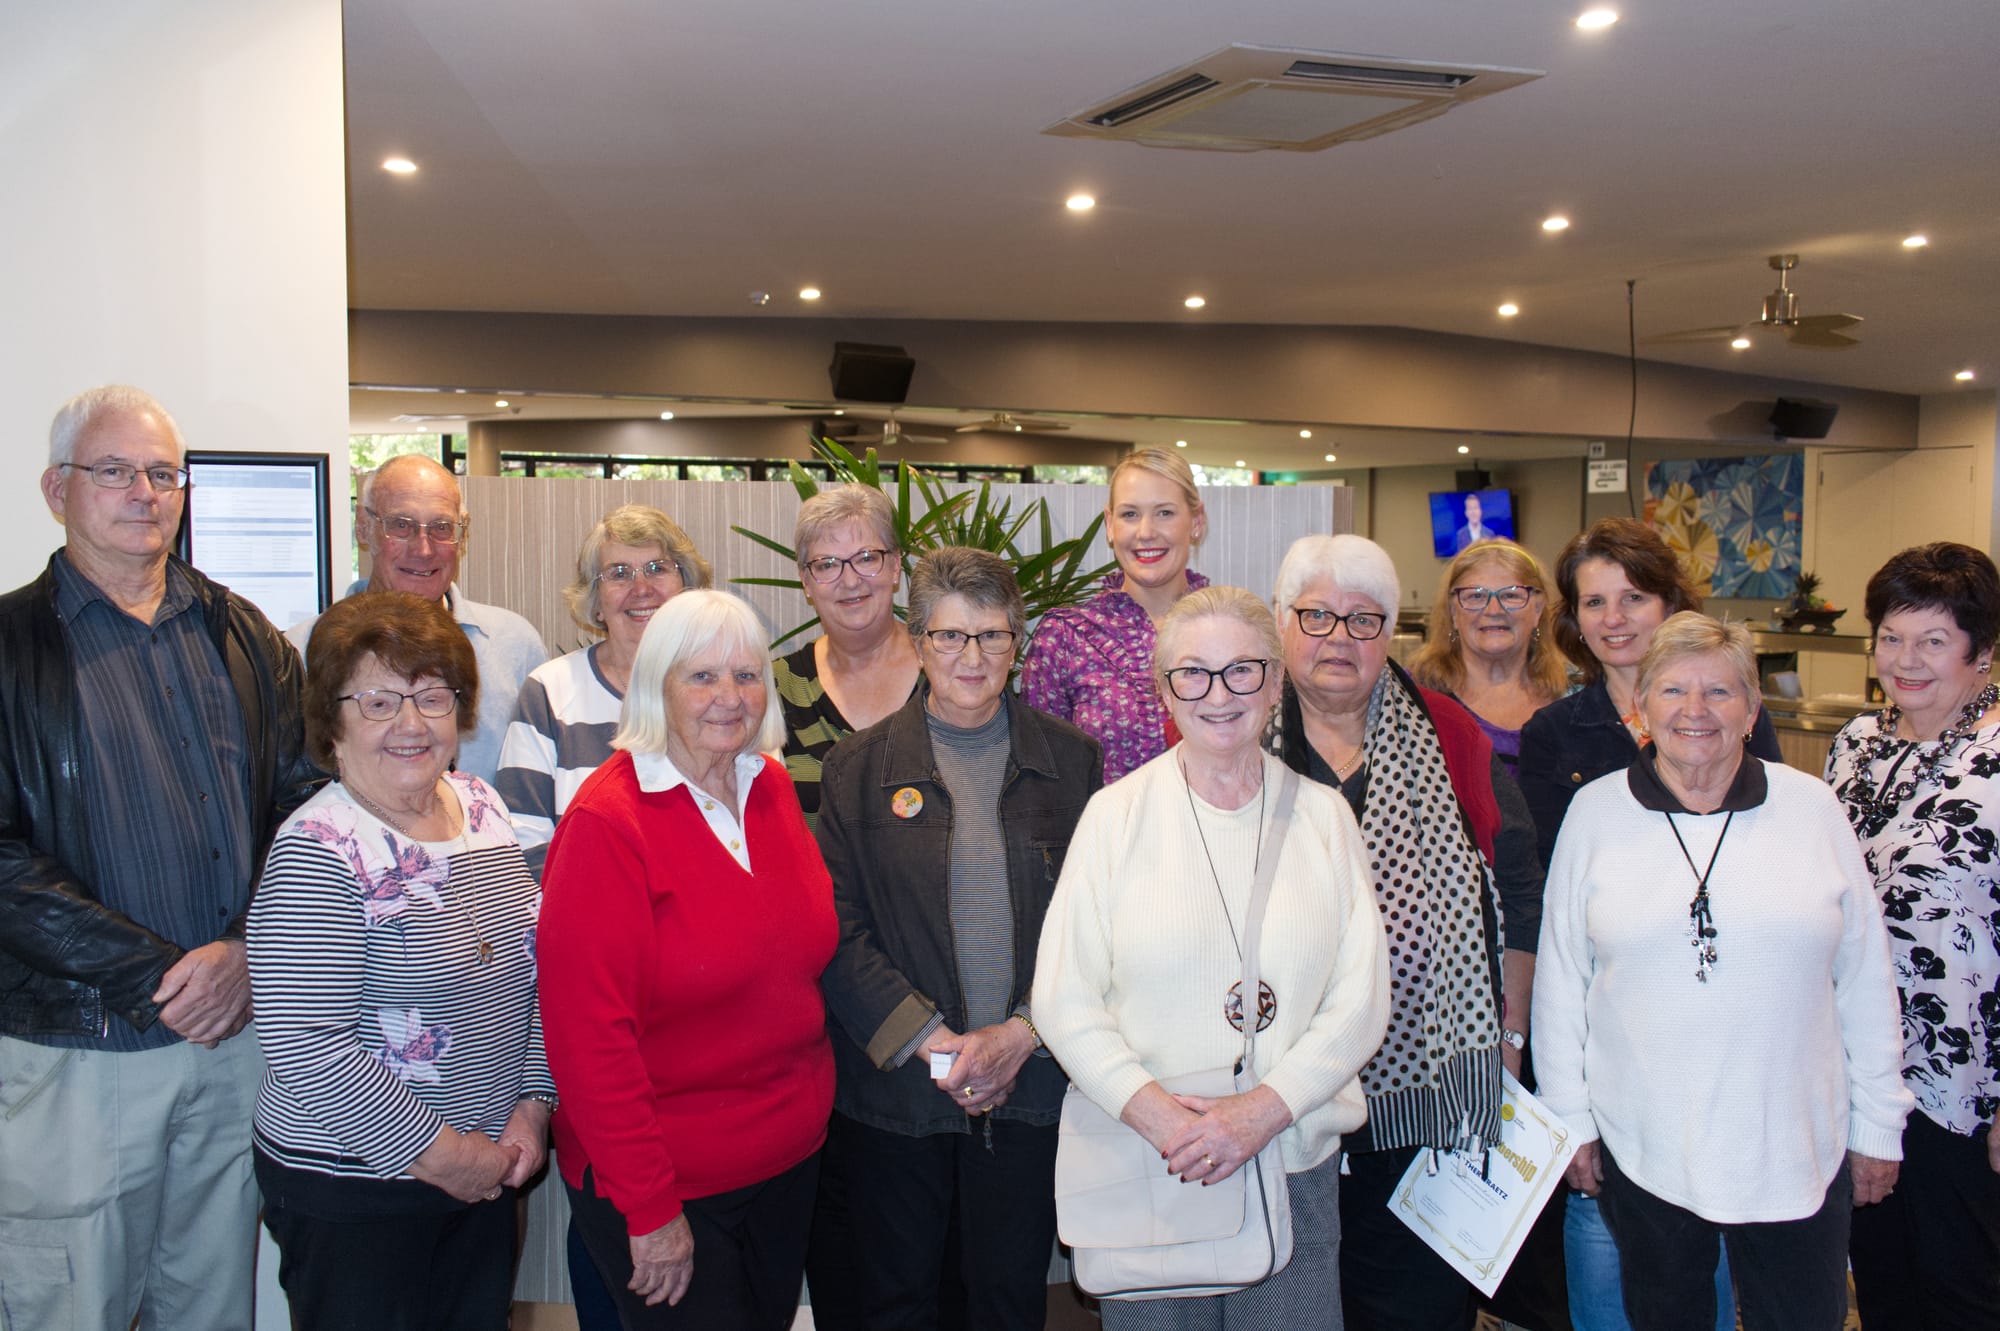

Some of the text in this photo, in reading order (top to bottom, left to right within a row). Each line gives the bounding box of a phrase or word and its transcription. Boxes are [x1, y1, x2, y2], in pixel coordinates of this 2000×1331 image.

[1452, 1149, 1482, 1178] HETHER
[1484, 1178, 1508, 1200] RAETZ
[1496, 1141, 1537, 1183] bership
